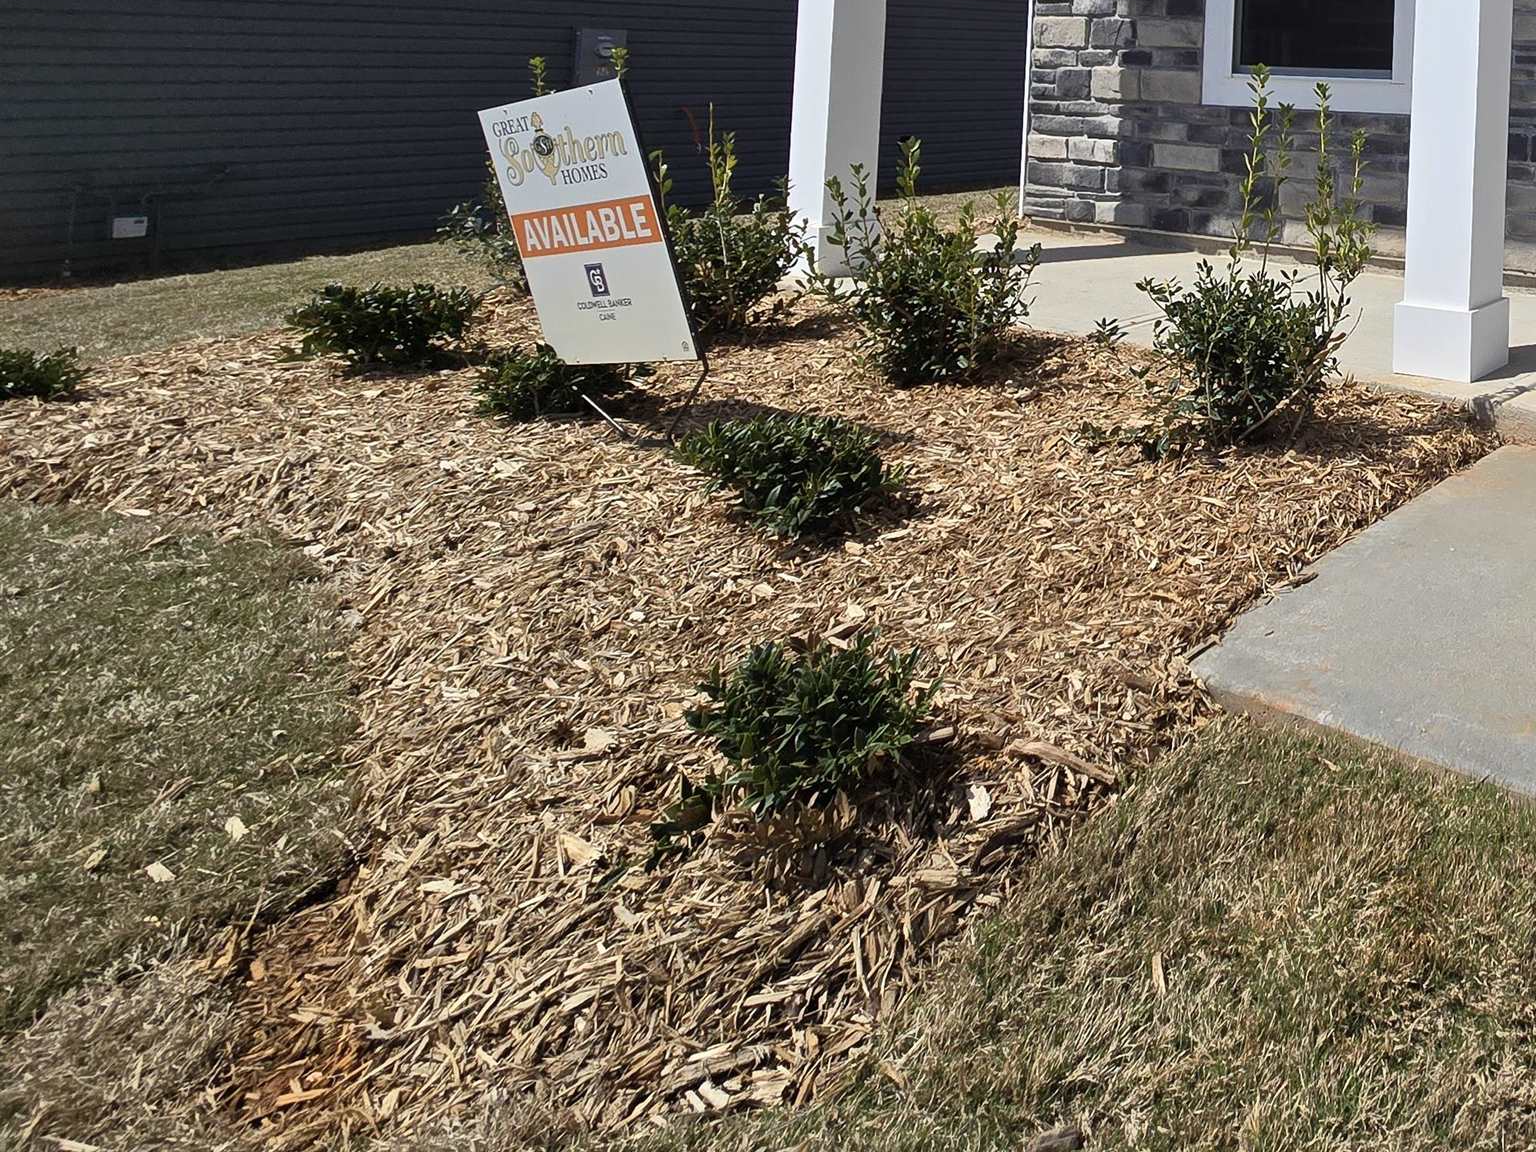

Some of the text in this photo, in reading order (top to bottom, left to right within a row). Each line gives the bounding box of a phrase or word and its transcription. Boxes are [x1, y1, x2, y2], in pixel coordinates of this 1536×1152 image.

[492, 116, 529, 137] GREAT
[499, 125, 628, 187] Southern
[561, 163, 608, 185] HOMES
[522, 201, 653, 252] AVAILABLE
[577, 297, 633, 310] COLDWELL BANKER
